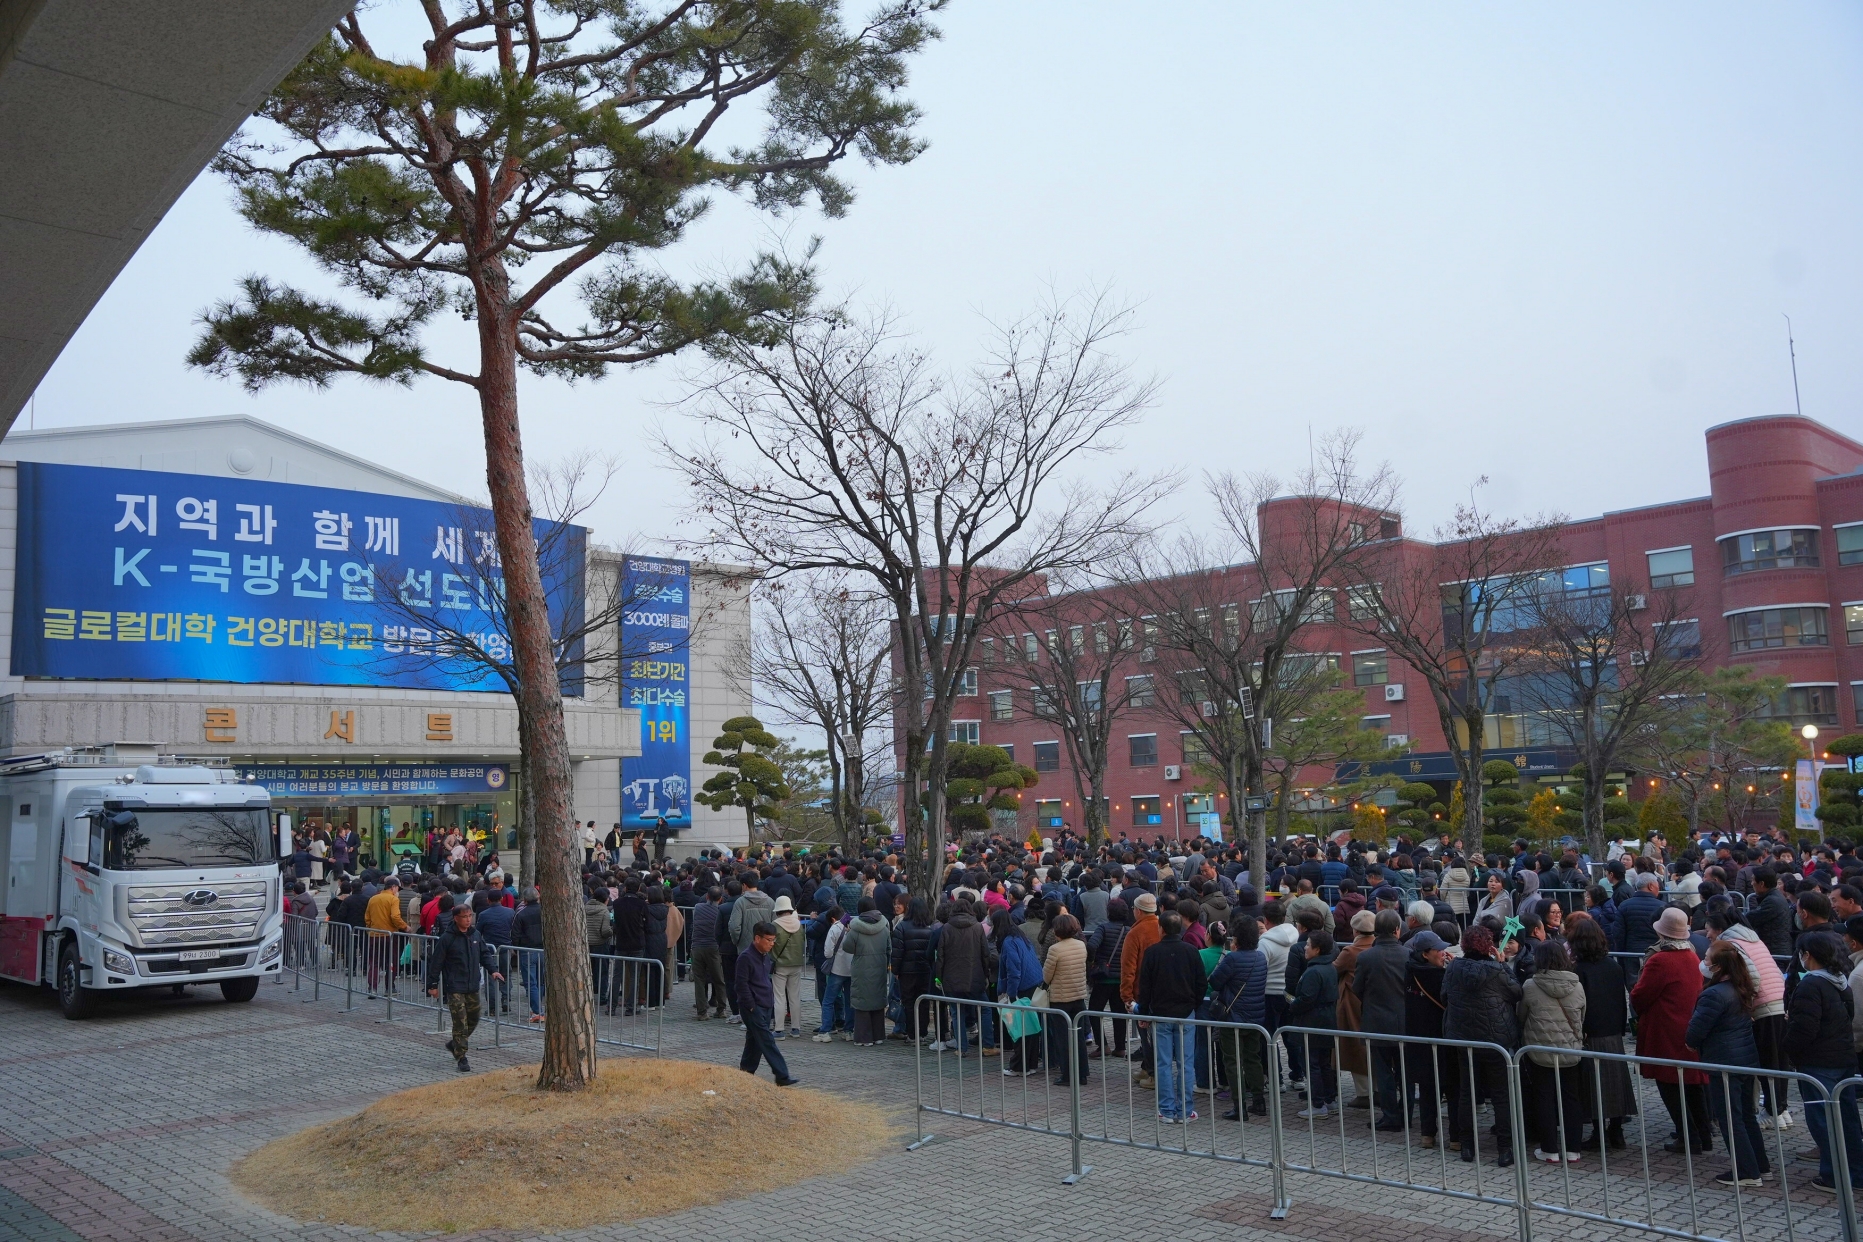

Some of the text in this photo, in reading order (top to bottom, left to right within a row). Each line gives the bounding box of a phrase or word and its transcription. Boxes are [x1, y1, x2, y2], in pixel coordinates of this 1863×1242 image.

[114, 493, 278, 545] 지역과
[312, 509, 399, 556] 함께
[114, 547, 375, 602] K-국방산업
[43, 607, 217, 644] 글로컬대학
[227, 616, 374, 650] 건양대학교
[384, 624, 458, 657] 방문을
[671, 614, 689, 629] 돌파
[630, 660, 686, 681] 최단기간
[630, 686, 686, 707] 최다수술
[646, 720, 676, 743] 1위
[247, 769, 297, 780] 건양대학교
[300, 769, 319, 779] 개교
[322, 769, 356, 779] 35주년
[359, 769, 380, 780] 기념,
[383, 768, 410, 779] 시민과
[413, 768, 447, 779] 함께하는
[450, 767, 484, 778] 문화공연
[267, 780, 439, 792] 시민 여러분들의 본교 방문을 환영합니다.
[199, 950, 217, 958] 2300
